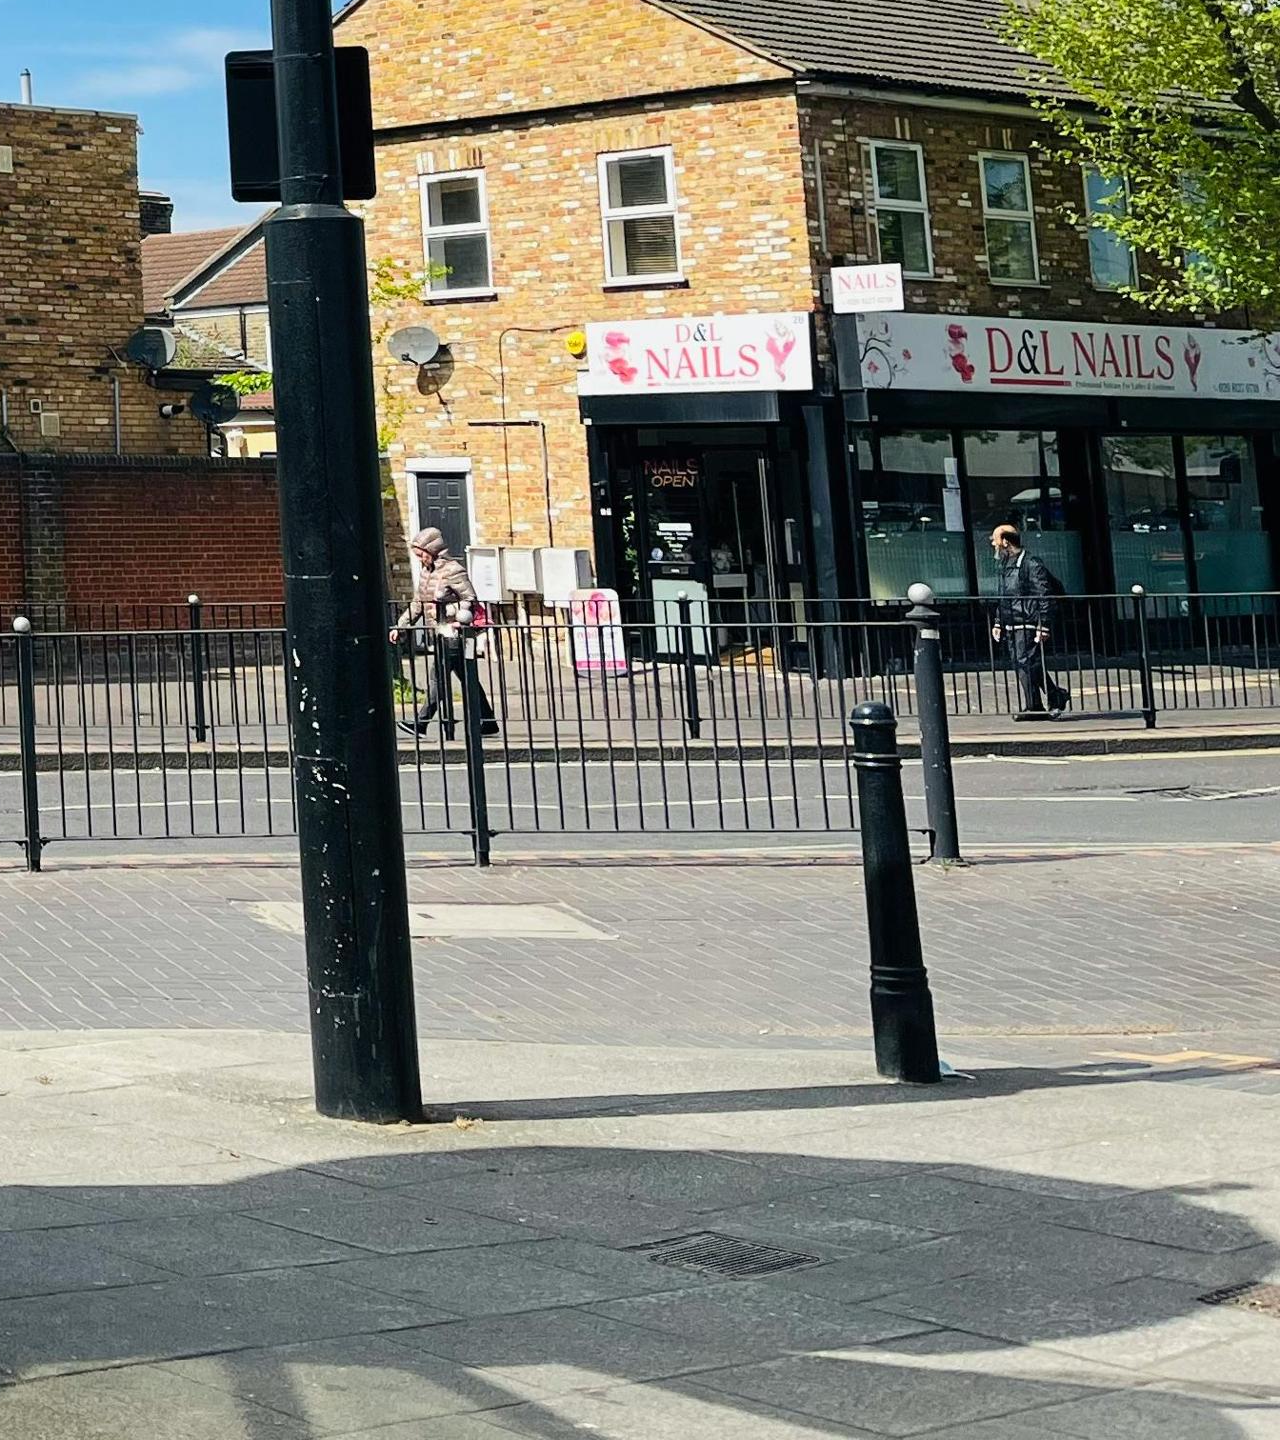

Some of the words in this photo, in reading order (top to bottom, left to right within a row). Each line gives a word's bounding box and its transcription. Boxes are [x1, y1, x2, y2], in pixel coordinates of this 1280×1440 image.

[838, 272, 897, 290] NAILS
[675, 323, 722, 343] D&L
[646, 344, 760, 380] NAILS
[986, 327, 1064, 376] D&L
[1071, 331, 1175, 380] NAILS
[644, 459, 698, 474] NAILS
[651, 476, 695, 487] OPEN
